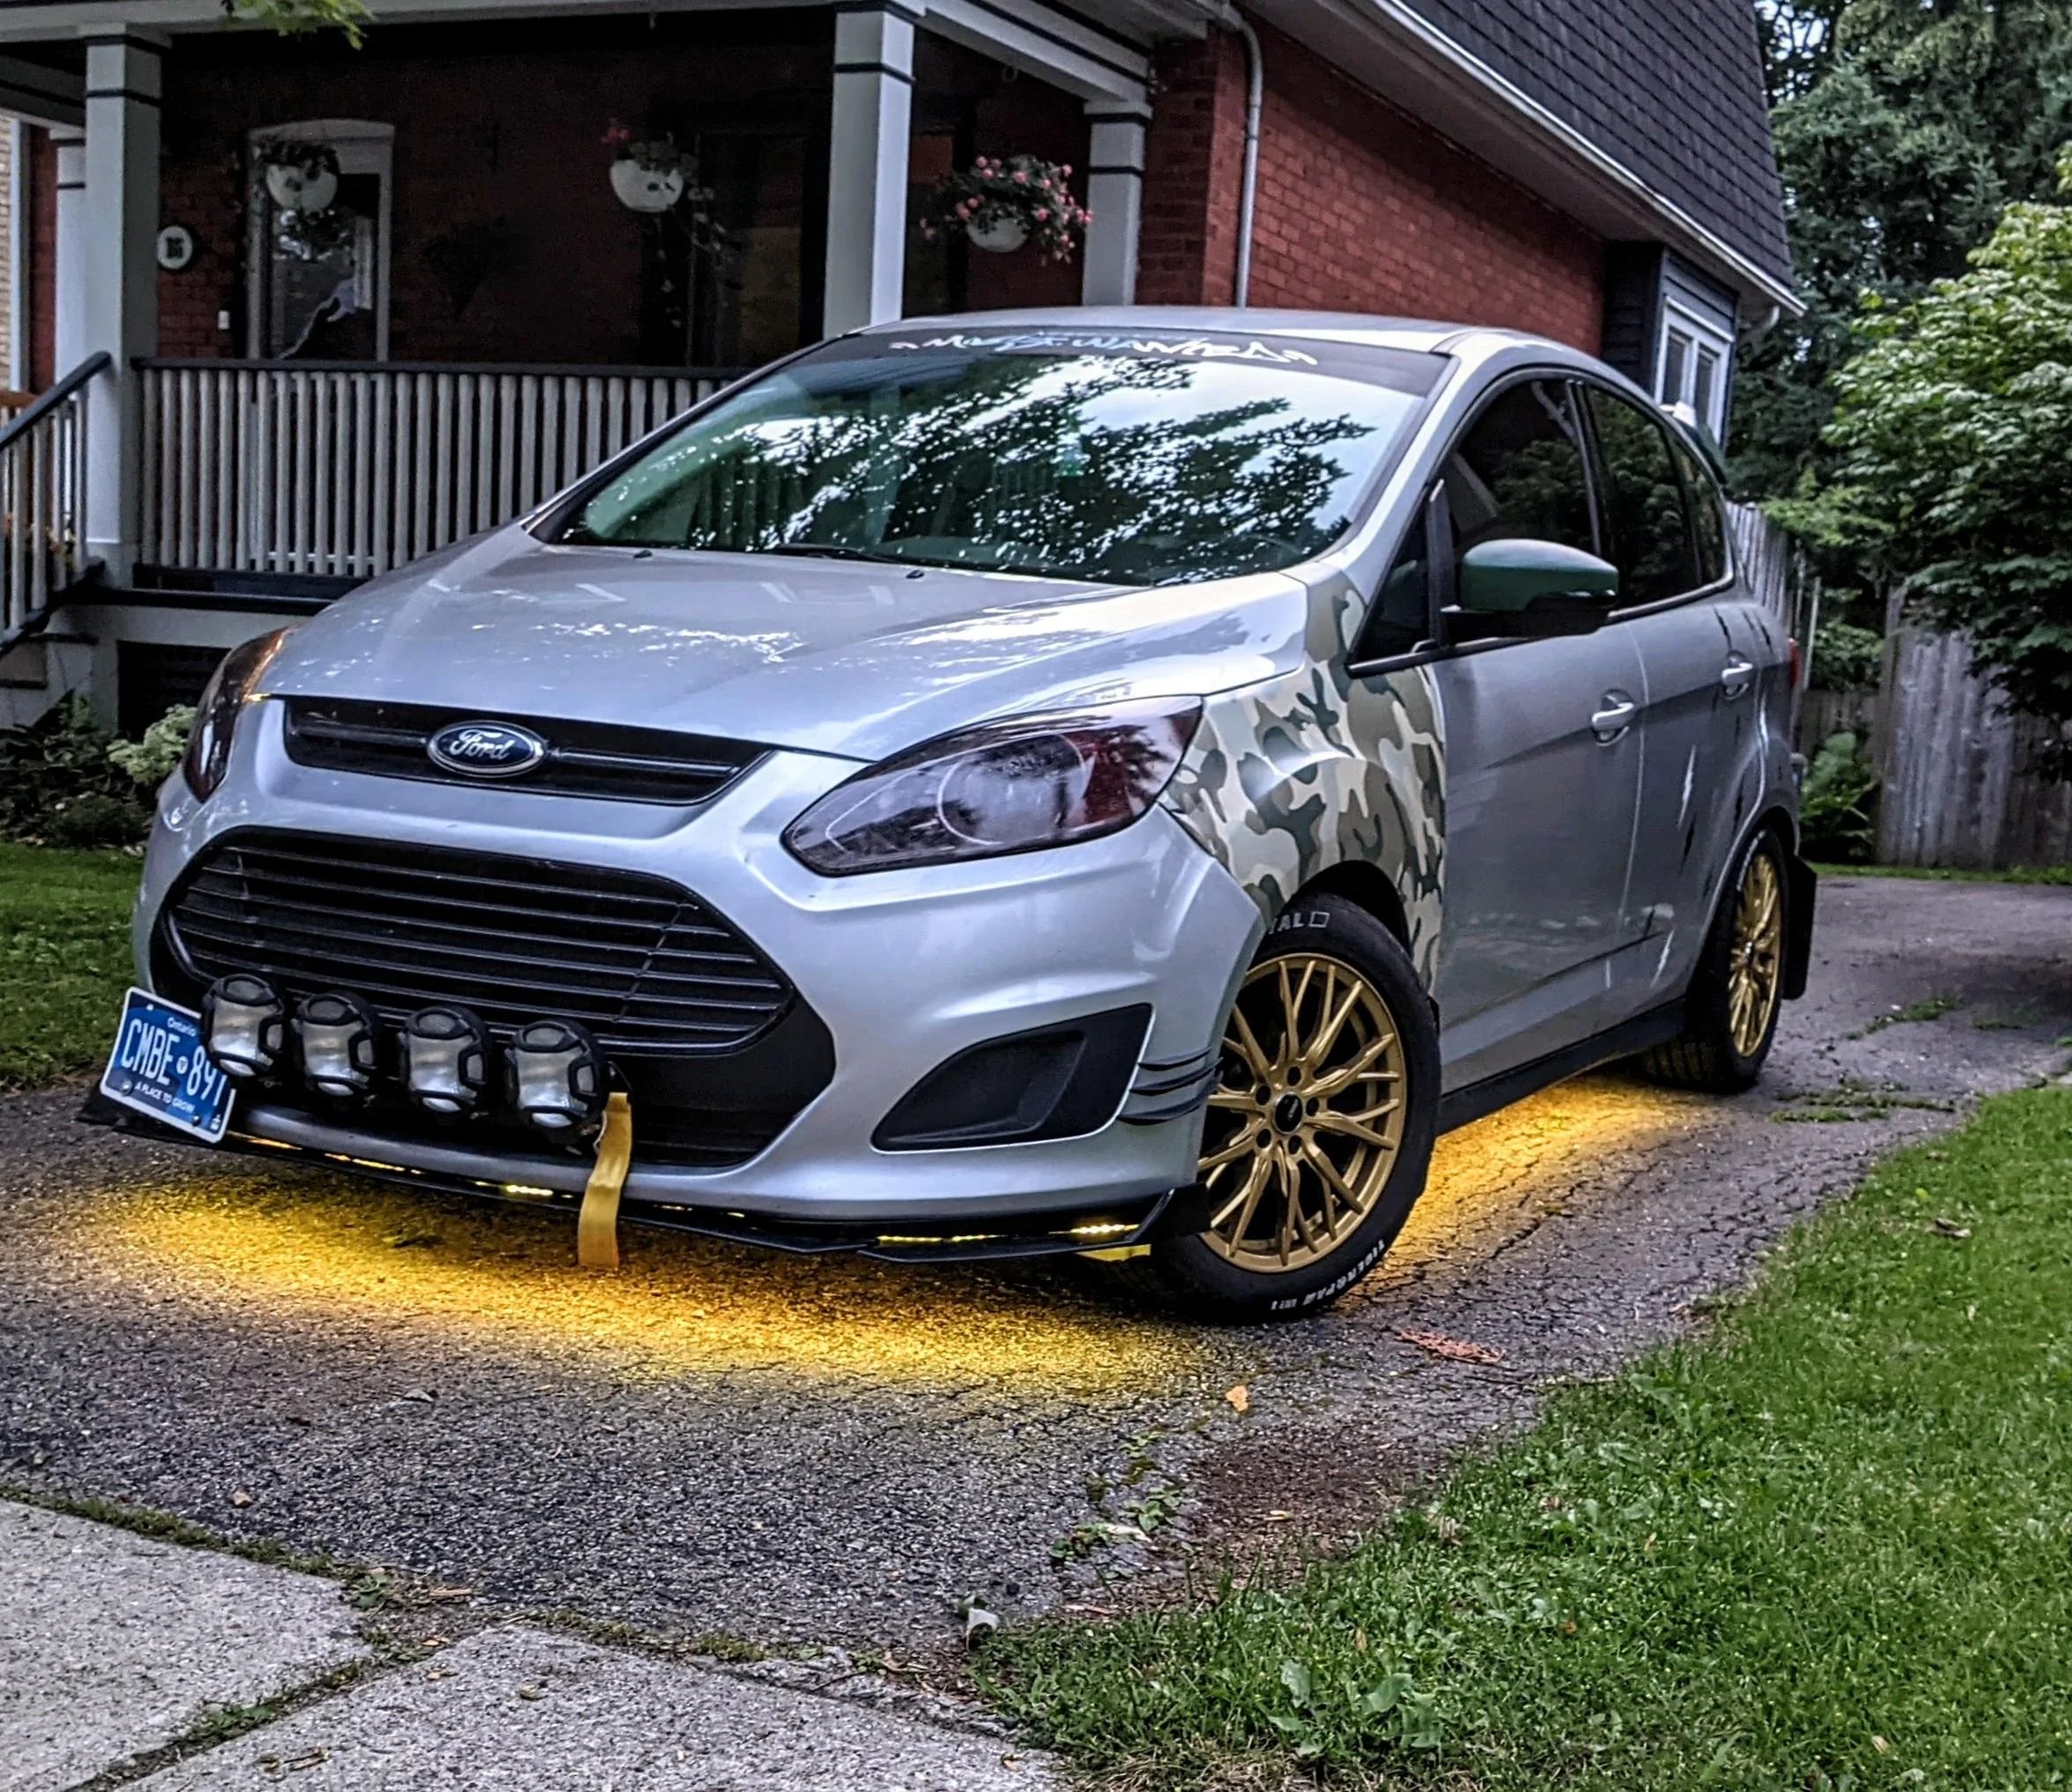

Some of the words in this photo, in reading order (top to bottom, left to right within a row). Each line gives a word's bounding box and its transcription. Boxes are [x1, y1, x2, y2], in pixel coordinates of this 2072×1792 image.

[448, 729, 515, 760] Ford
[166, 1017, 197, 1037] Ontario
[121, 1018, 180, 1086] CMBE
[134, 1082, 143, 1092] A
[143, 1085, 162, 1100] PLACE
[161, 1092, 173, 1105] TO
[172, 1097, 196, 1114] GROW
